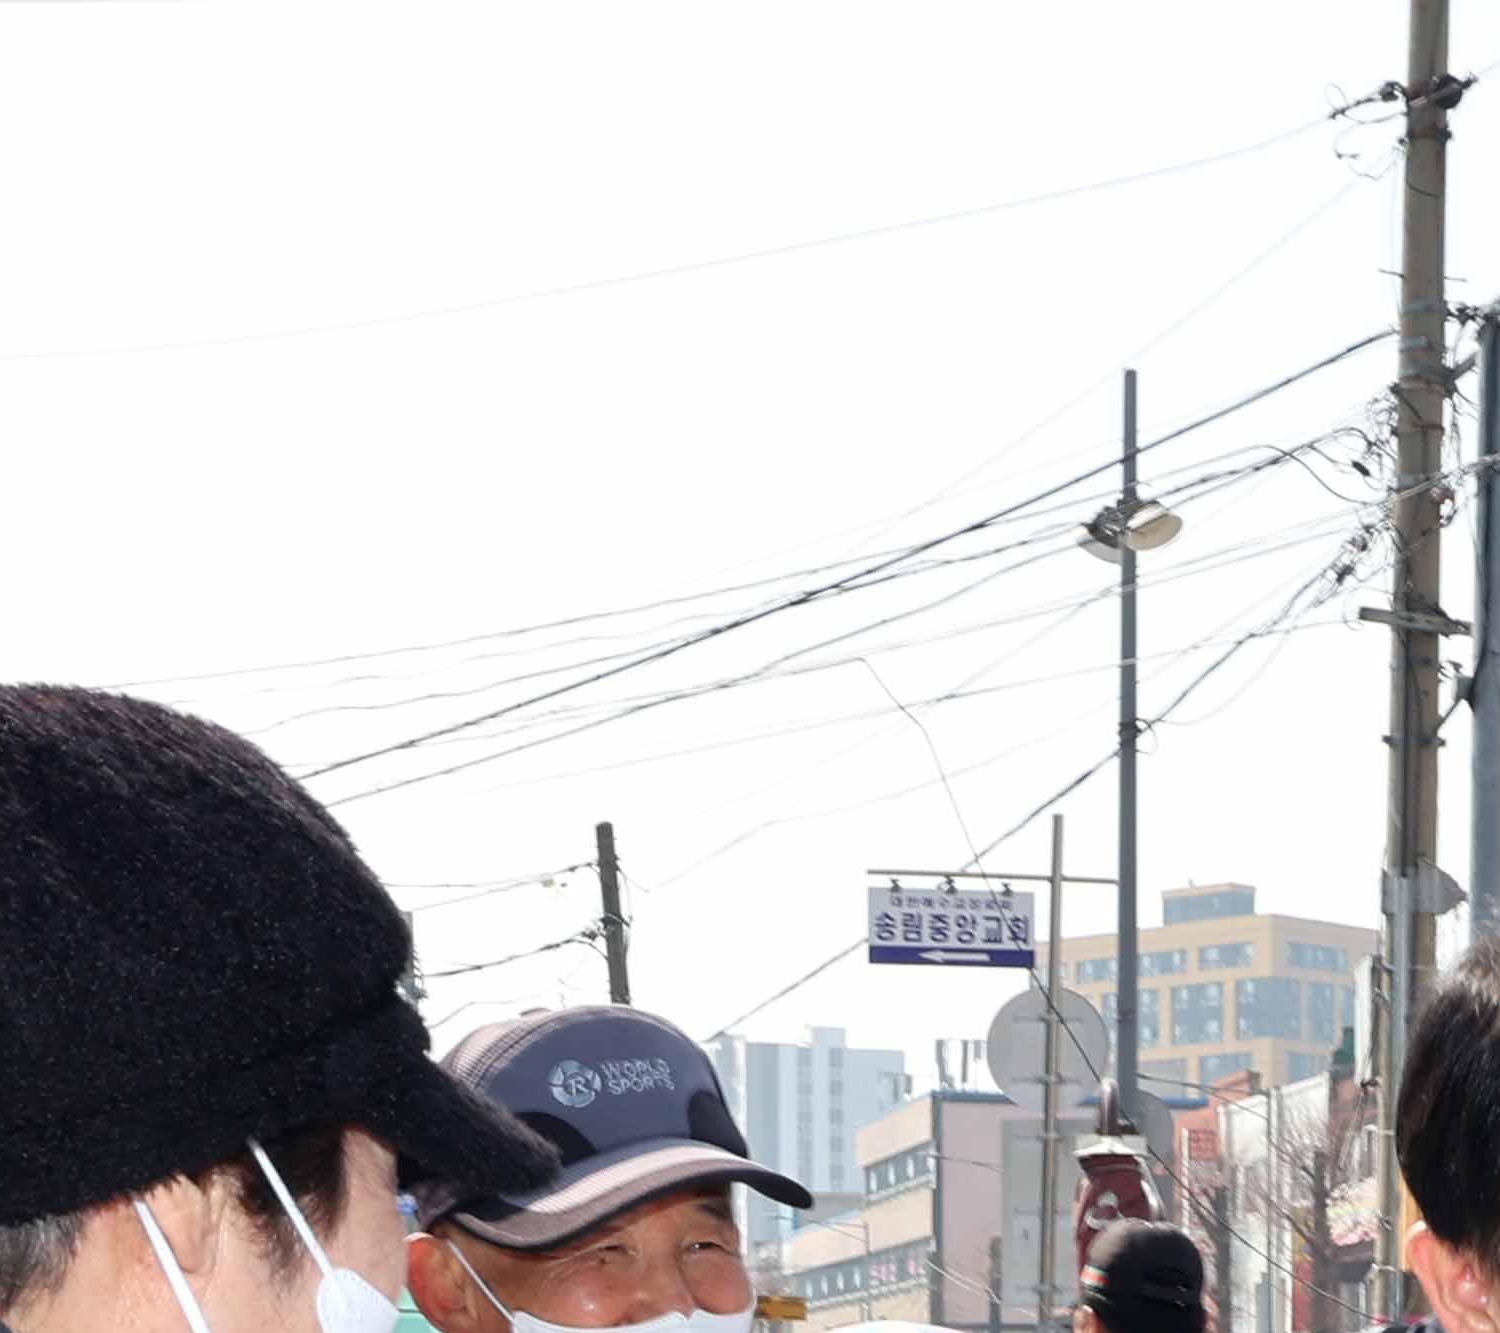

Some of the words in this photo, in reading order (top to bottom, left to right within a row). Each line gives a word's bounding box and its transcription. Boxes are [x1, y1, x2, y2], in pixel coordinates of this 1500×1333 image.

[875, 911, 1029, 945] 송림중앙교회
[601, 1057, 670, 1080] WORLD
[608, 1073, 675, 1096] SPORTS
